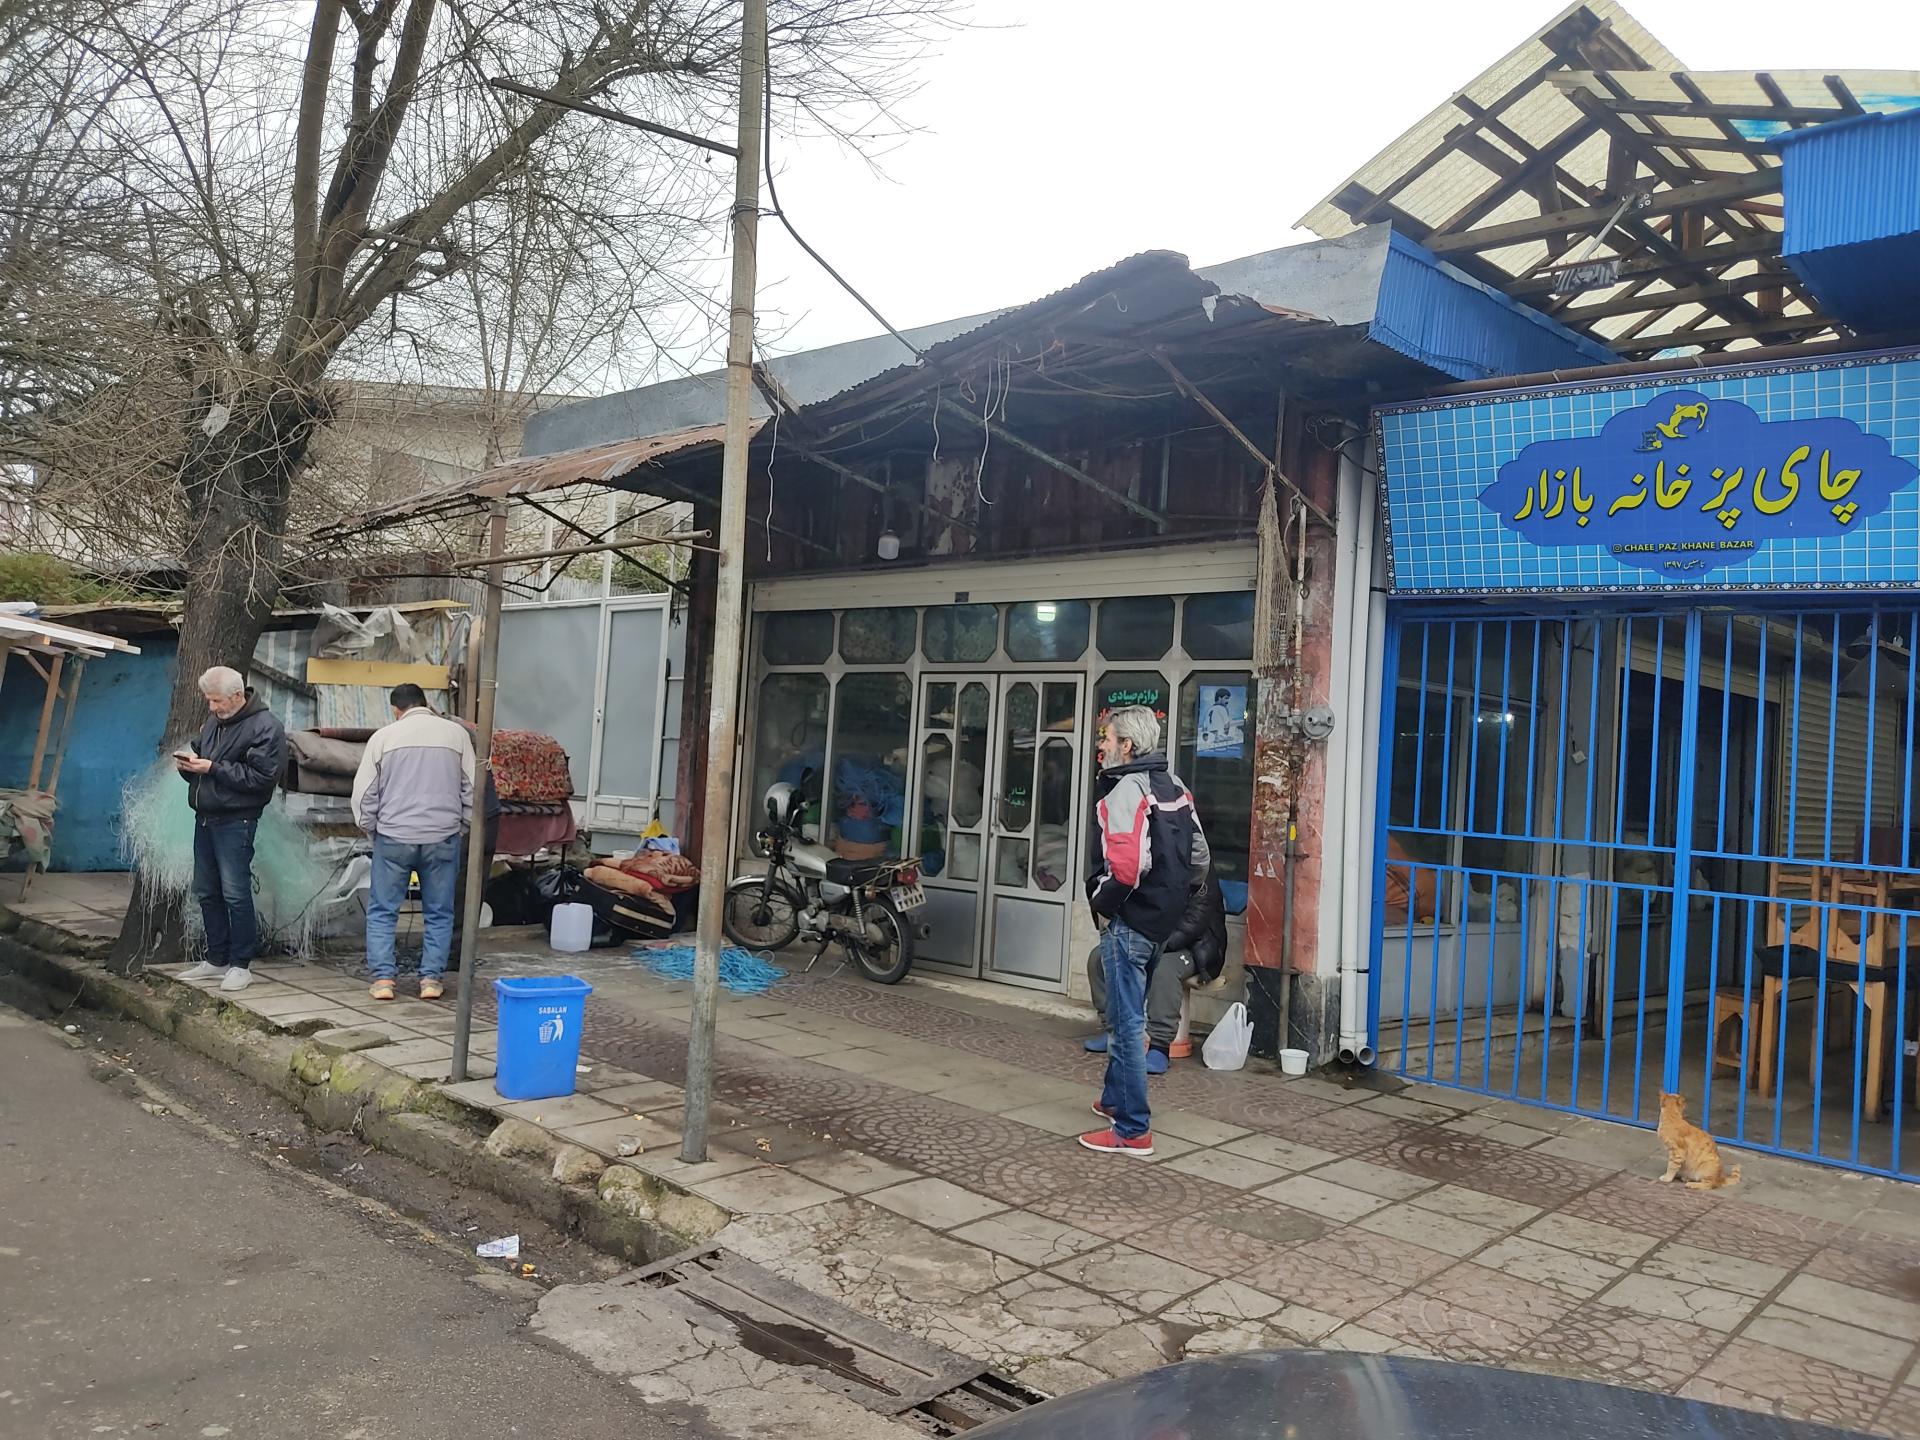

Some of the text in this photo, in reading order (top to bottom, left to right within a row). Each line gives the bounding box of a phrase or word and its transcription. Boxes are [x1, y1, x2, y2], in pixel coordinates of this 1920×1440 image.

[1513, 444, 1863, 530] چای پز خانه بازار
[1107, 689, 1159, 705] لوازم صیادی
[538, 1005, 568, 1015] SABALAN
